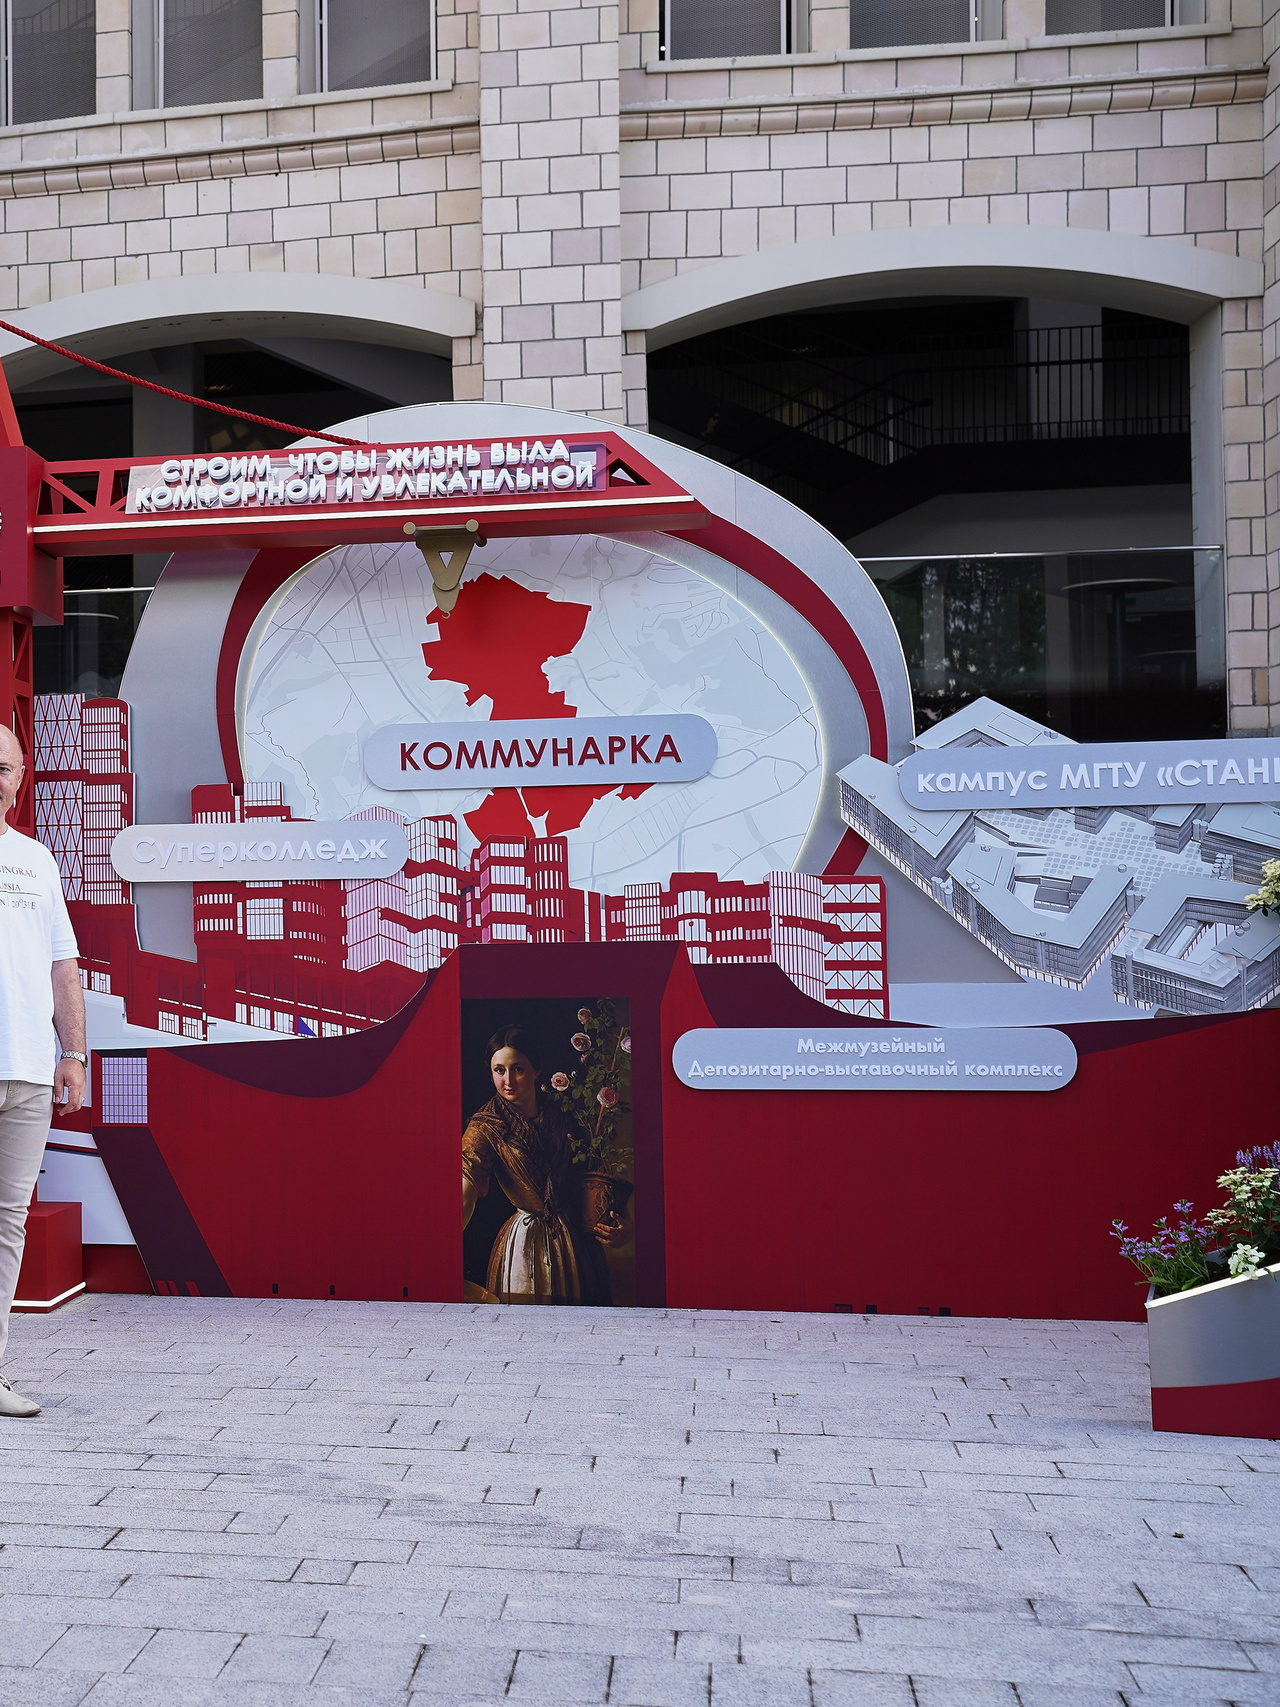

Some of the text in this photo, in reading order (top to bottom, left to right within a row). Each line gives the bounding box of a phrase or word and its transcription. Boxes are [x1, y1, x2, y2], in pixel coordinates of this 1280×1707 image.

[160, 439, 570, 483] СТРОИМ, ЧТОБЫ ЖИЗНЬ БЫЛА
[135, 461, 596, 511] КОМФОРТНОЙ И УВЛЕКАТЕЛЬНОЙ
[400, 734, 683, 771] КОММУНАРКА
[917, 769, 1048, 797] кампус
[1059, 761, 1147, 790] МГТУ
[131, 837, 389, 869] Суперколледж
[797, 1037, 945, 1057] Межмузейный
[687, 1060, 1063, 1081] Депозитарно-выставочный комплекс
